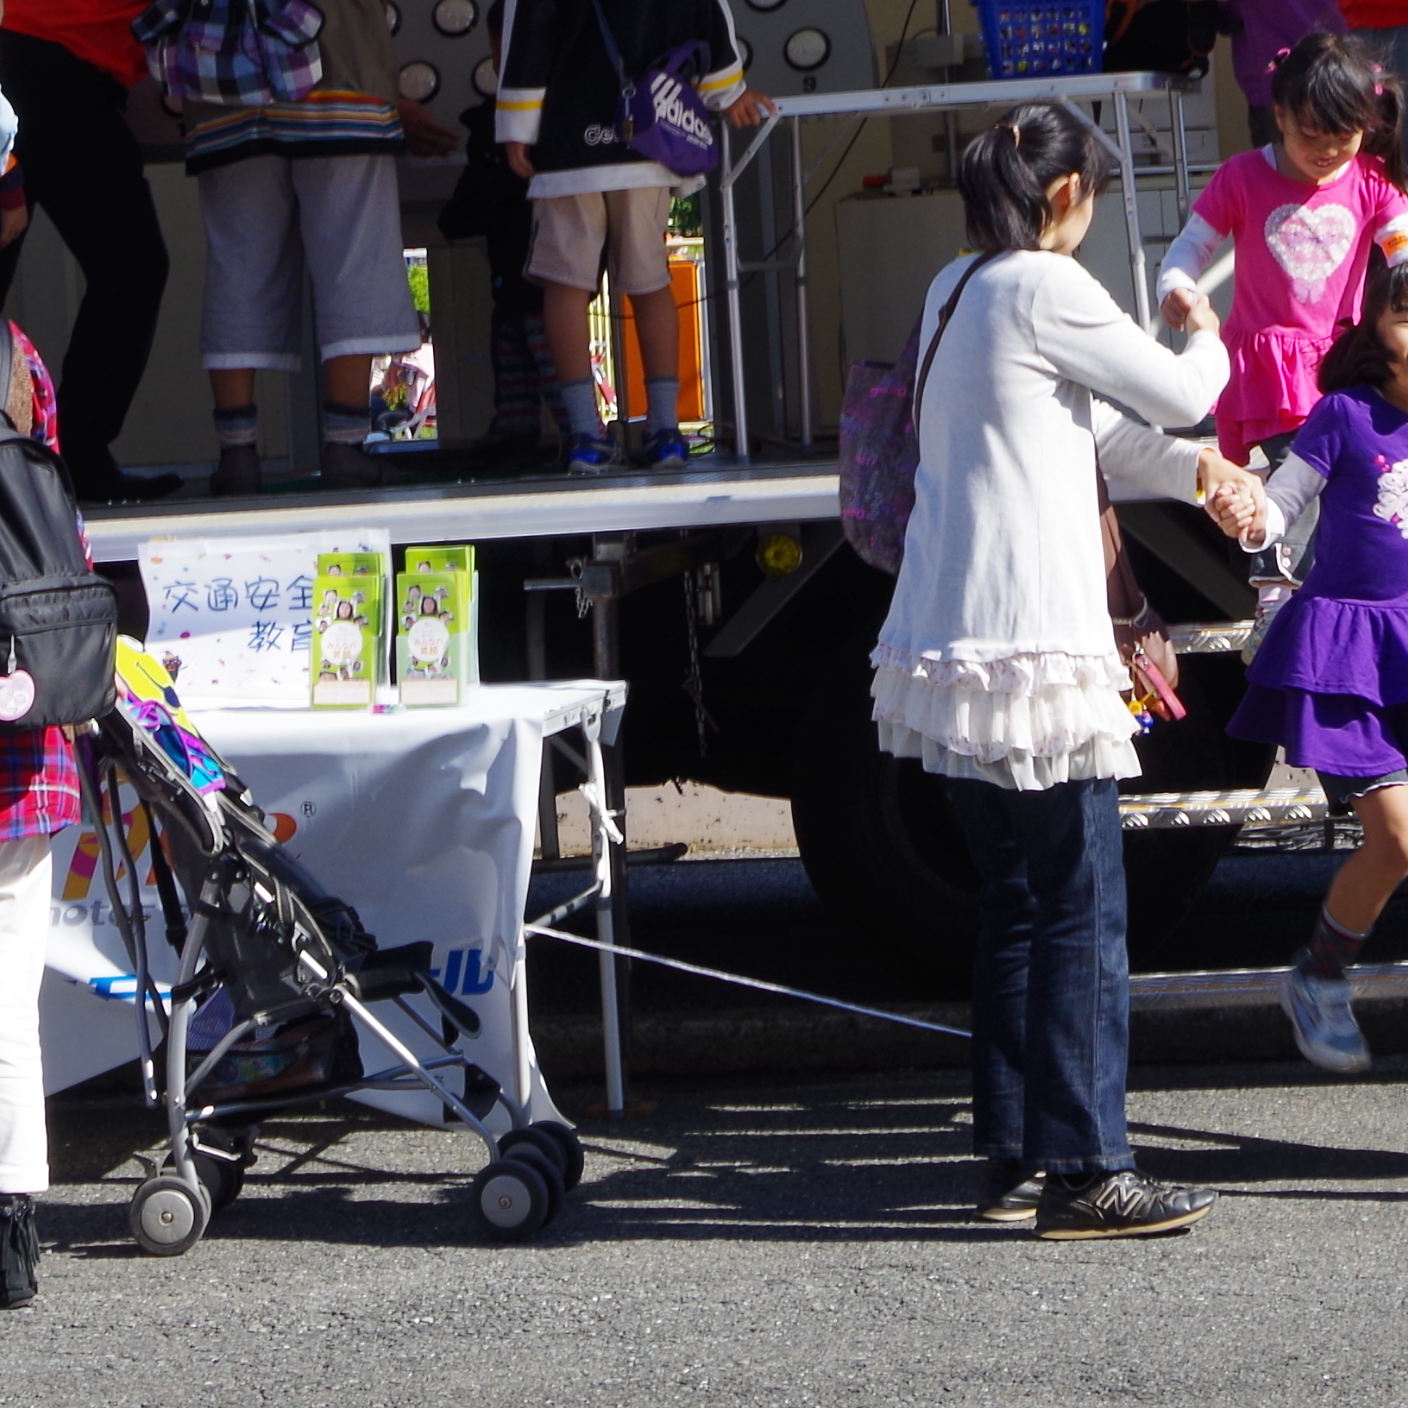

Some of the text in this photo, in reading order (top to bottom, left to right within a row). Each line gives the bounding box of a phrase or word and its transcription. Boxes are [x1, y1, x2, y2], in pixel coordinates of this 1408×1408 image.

[161, 574, 313, 614] 交通安全
[247, 617, 313, 654] 教育
